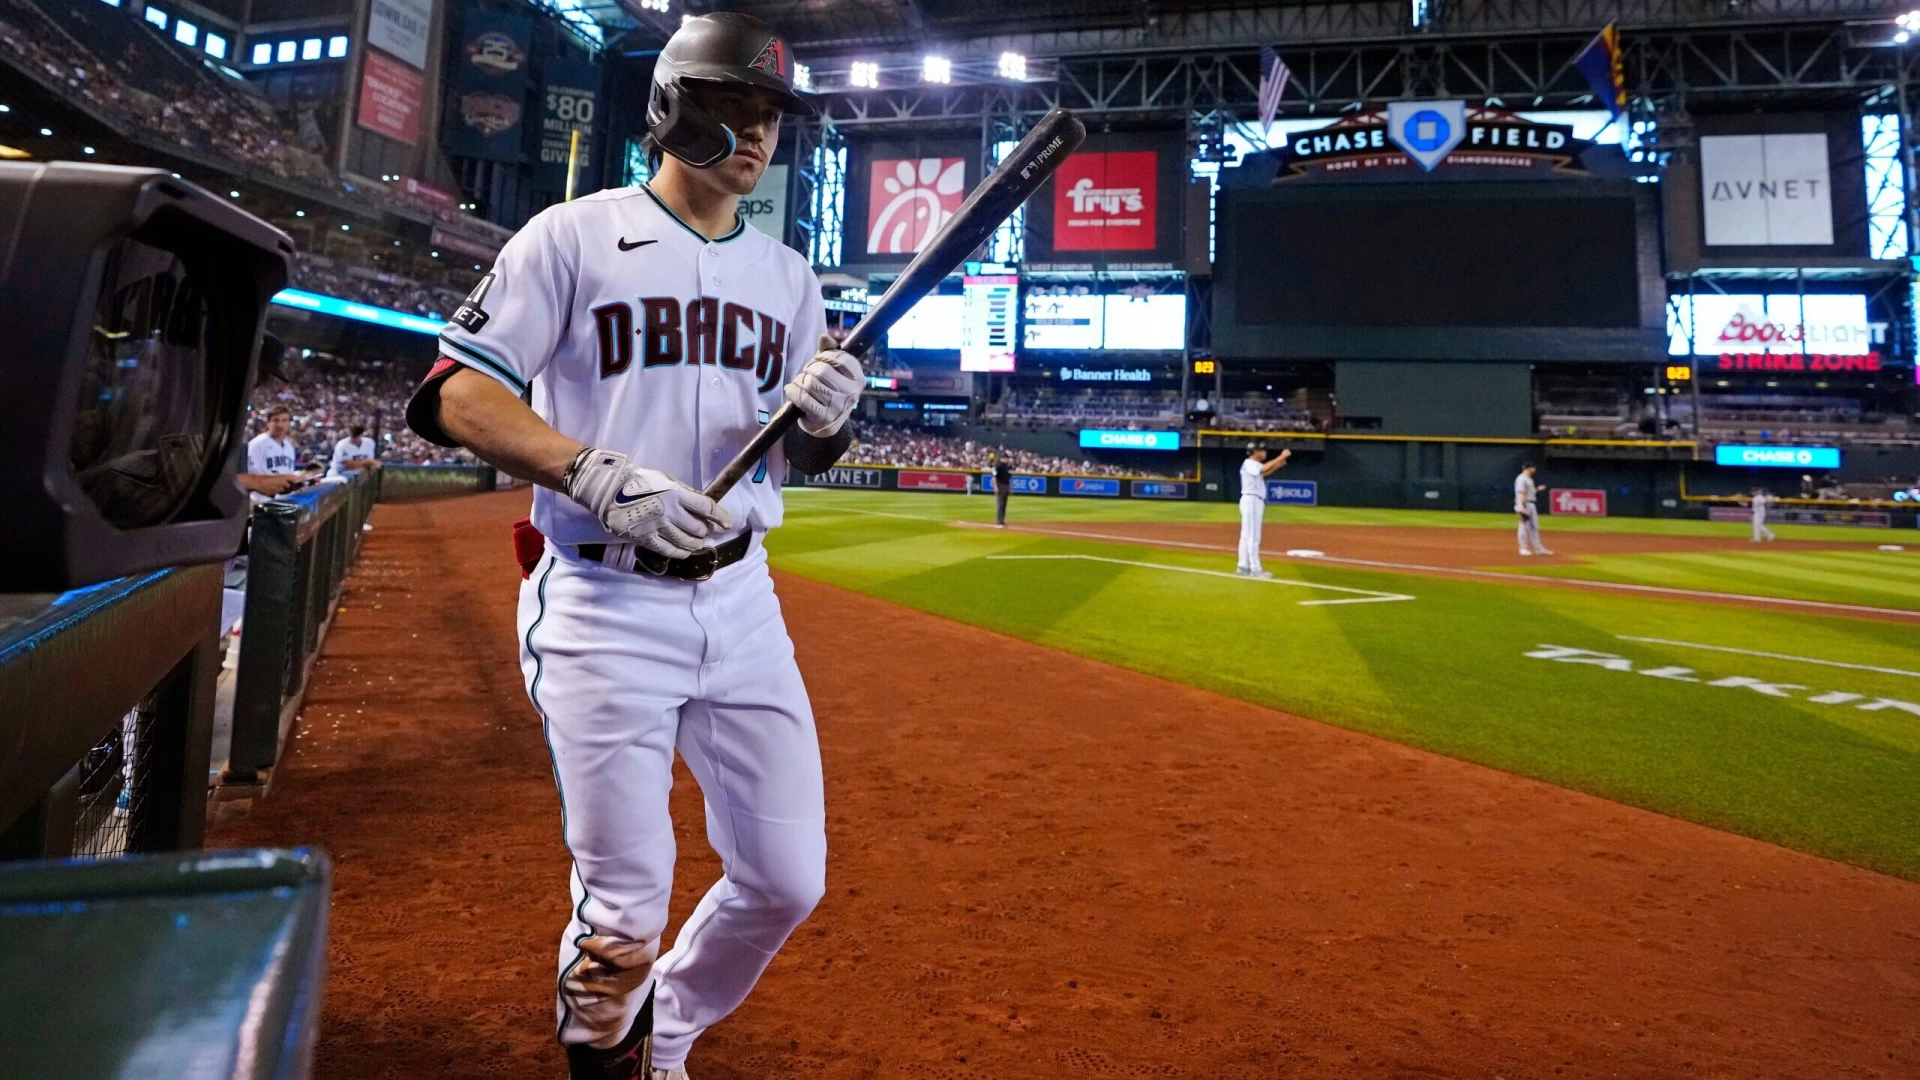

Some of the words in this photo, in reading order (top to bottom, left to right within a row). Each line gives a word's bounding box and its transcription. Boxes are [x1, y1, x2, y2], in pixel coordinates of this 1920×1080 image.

[546, 94, 595, 123] $80
[1036, 135, 1064, 164] PRIME
[1294, 129, 1385, 156] CHASE
[1472, 127, 1565, 149] FIELD
[1326, 158, 1358, 171] HOME
[1364, 157, 1380, 167] OF
[1386, 156, 1408, 166] THE
[1447, 154, 1532, 167] DIAMONDBACKS
[1066, 178, 1145, 215] fry's
[1711, 179, 1821, 201] AVNET
[737, 199, 774, 219] aps
[1809, 322, 1889, 344] LIGHT
[1719, 352, 1804, 371] STRIKE
[1809, 351, 1882, 371] ZONE
[1073, 368, 1114, 381] Banner
[1114, 368, 1151, 381] Health
[1100, 433, 1144, 445] CHASE
[1742, 450, 1795, 463] CHASE
[813, 469, 875, 485] AVNET
